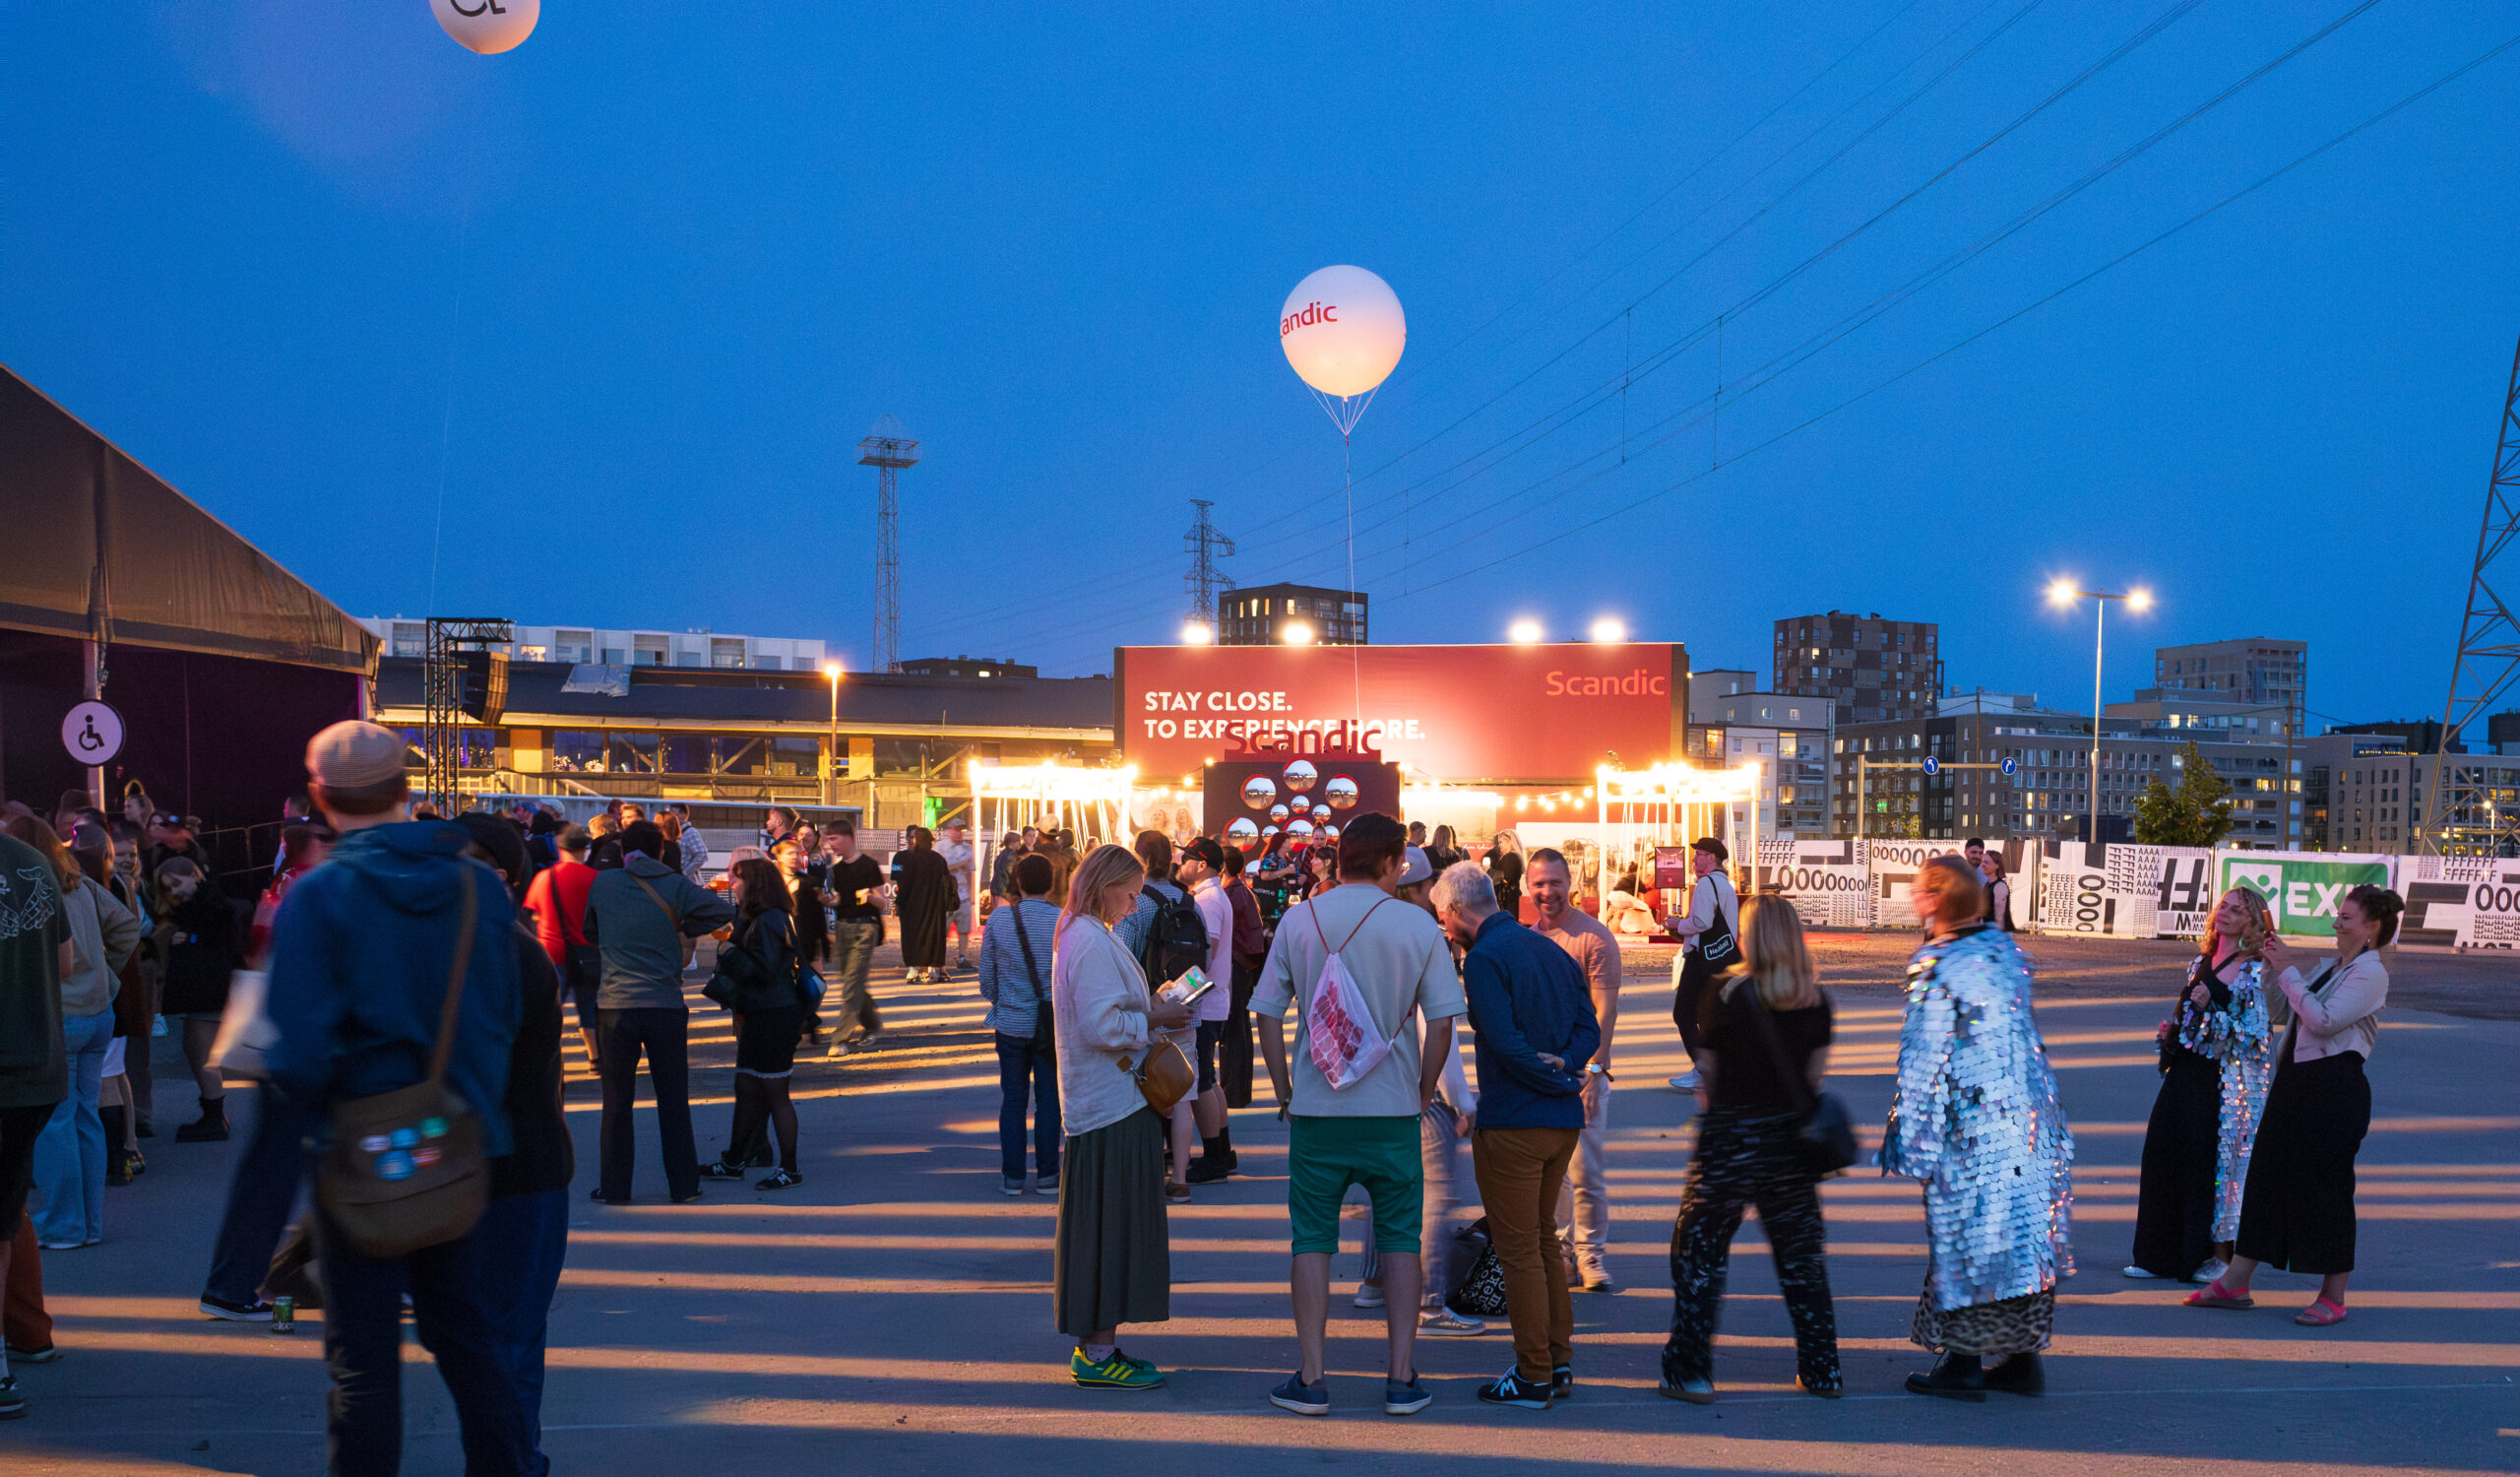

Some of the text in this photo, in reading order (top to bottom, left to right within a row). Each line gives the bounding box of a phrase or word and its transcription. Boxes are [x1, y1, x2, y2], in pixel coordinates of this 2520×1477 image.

[1281, 301, 1338, 339] andic
[1545, 669, 1666, 696] Scandic
[1145, 692, 1292, 711] STAY CLOSE.
[1144, 720, 1177, 738] TO
[1225, 720, 1382, 753] Scandic
[2286, 881, 2381, 918] EX
